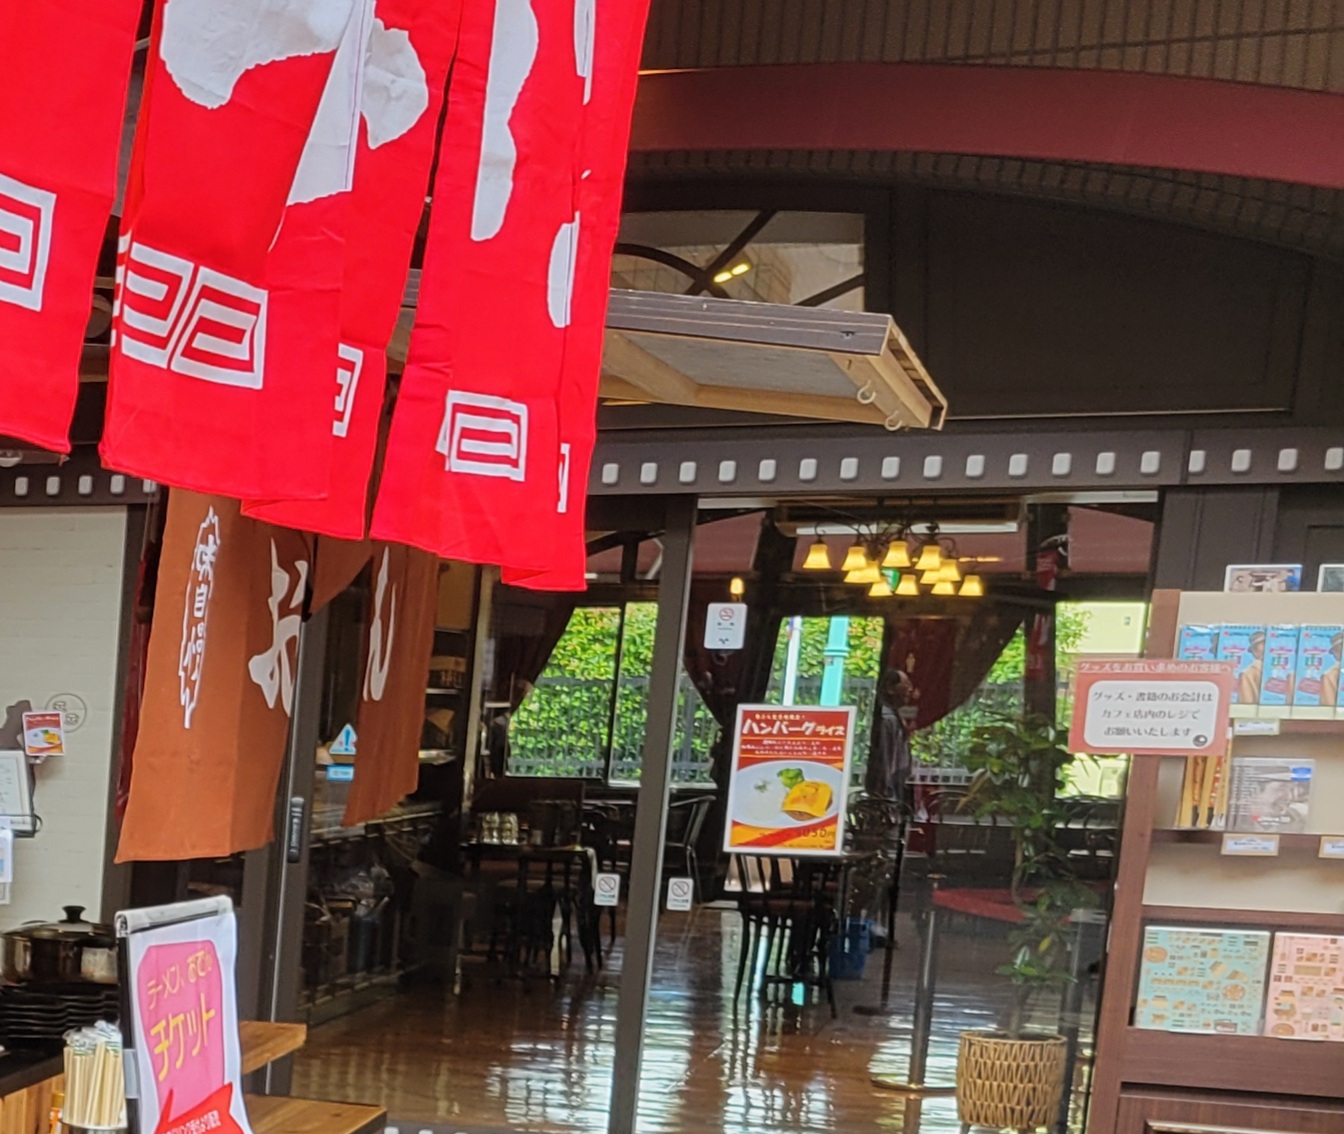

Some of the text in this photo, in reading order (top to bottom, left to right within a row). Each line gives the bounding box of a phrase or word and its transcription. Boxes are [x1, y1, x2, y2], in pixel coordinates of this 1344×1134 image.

[1101, 708, 1200, 720] カフェ店内のレジで
[1103, 726, 1192, 737] お願いいたします
[150, 992, 216, 1081] チケット
